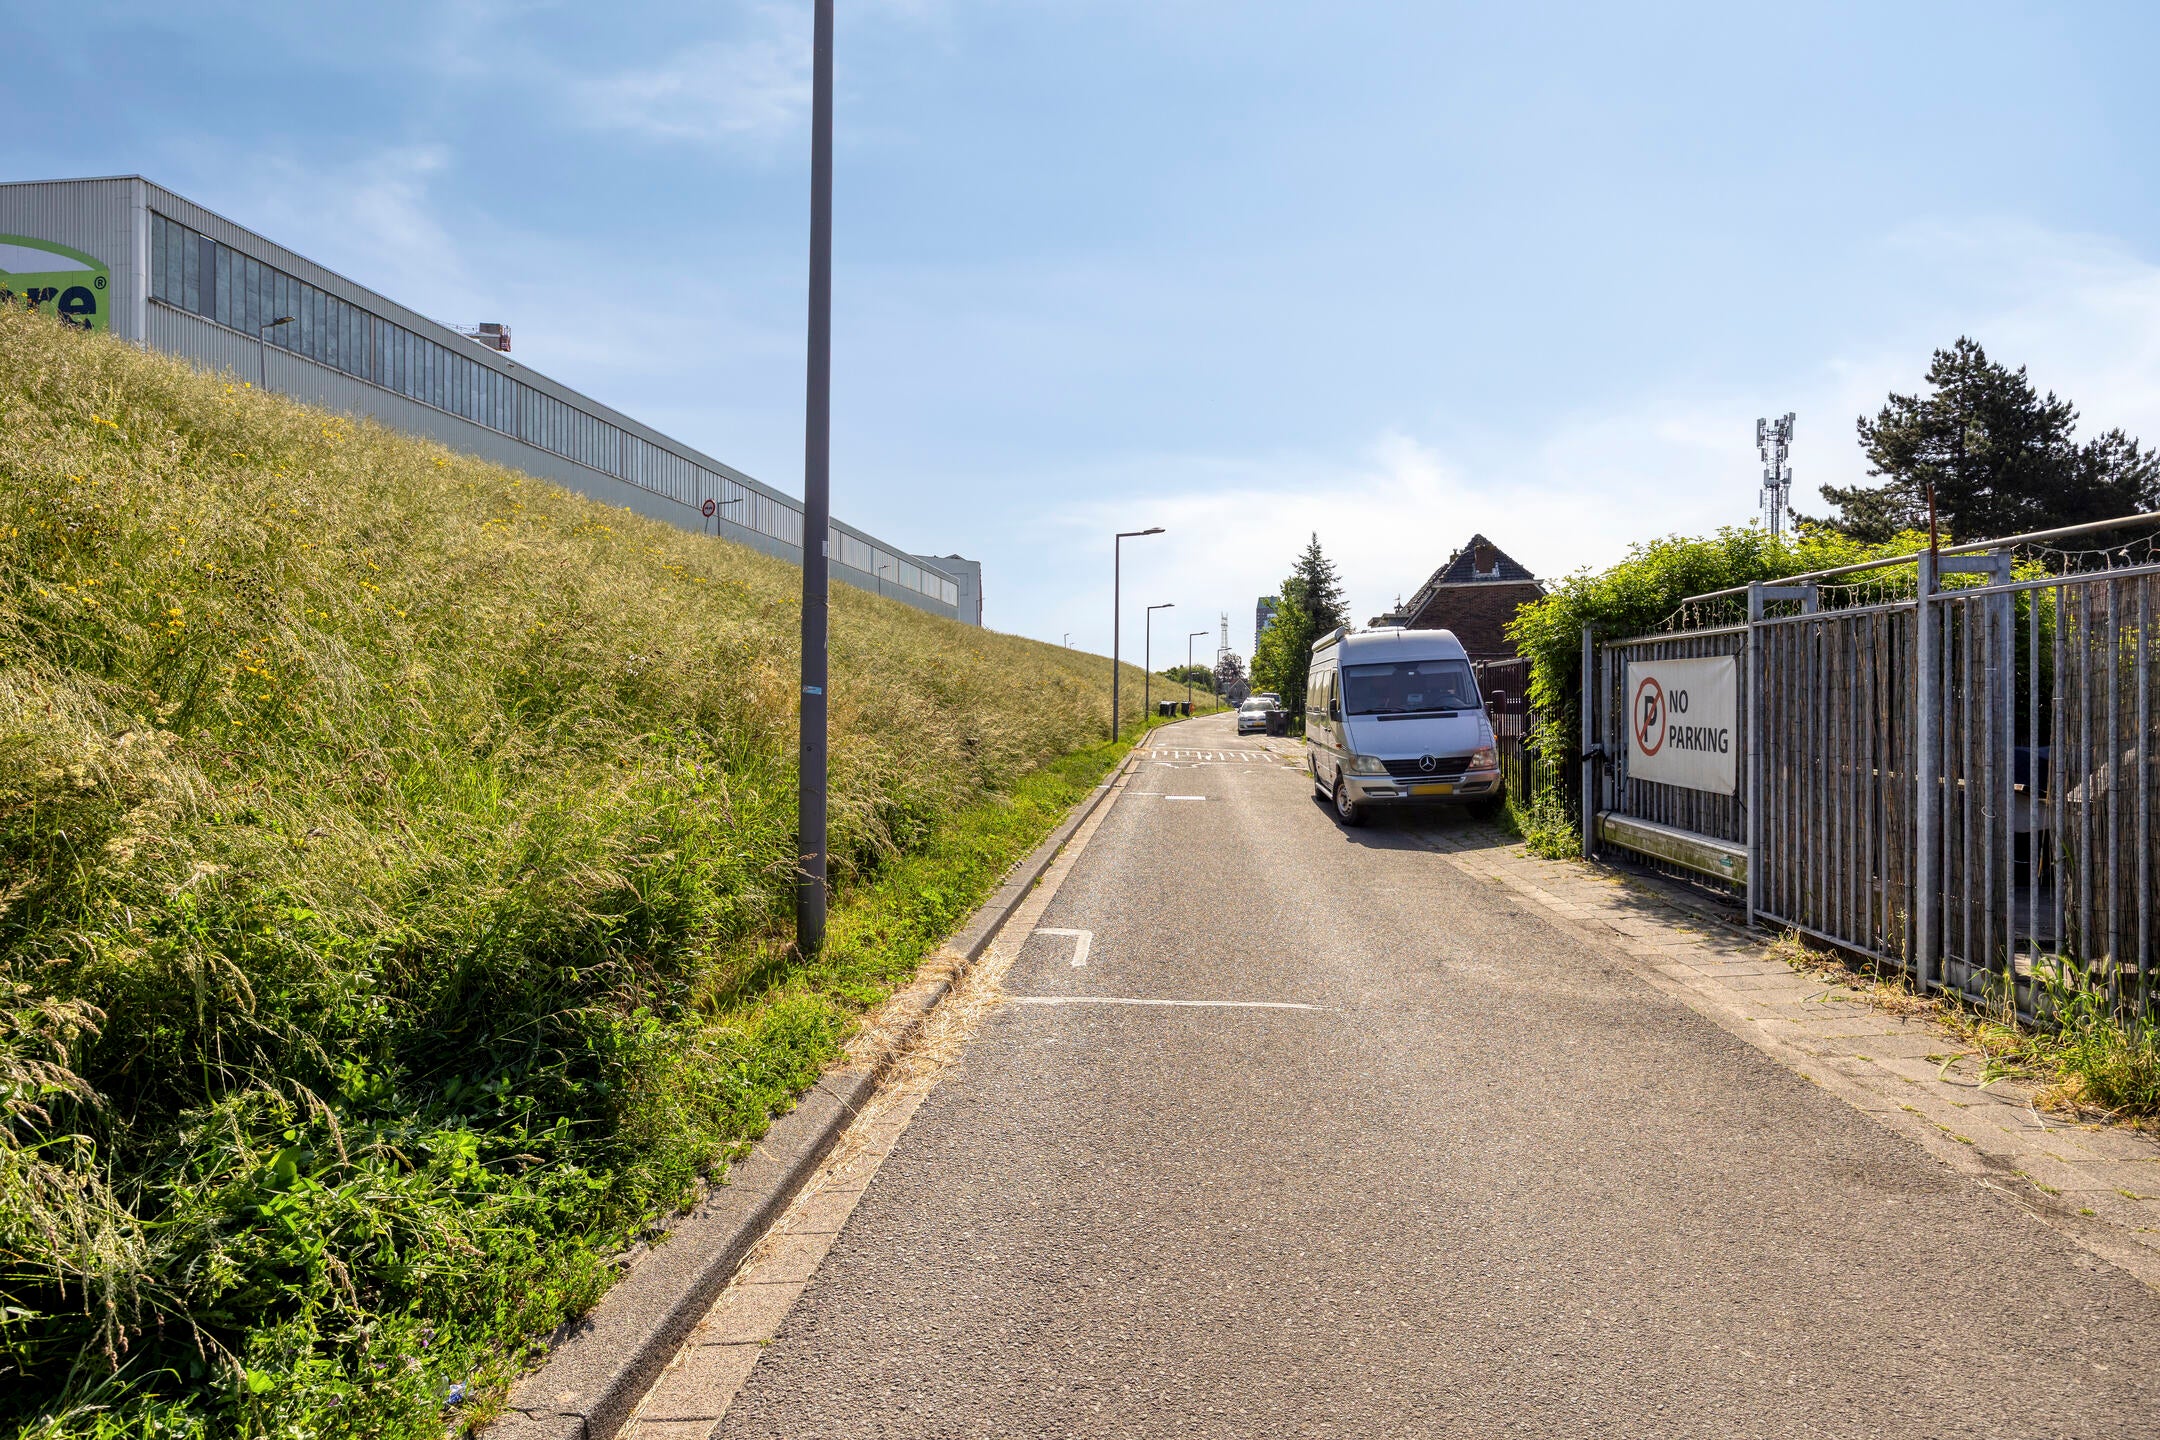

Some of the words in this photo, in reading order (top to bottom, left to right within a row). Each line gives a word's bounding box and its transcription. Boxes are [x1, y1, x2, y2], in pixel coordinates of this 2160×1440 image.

[0, 286, 97, 330] re
[1669, 689, 1689, 714] NO
[1669, 725, 1729, 754] PARKING
